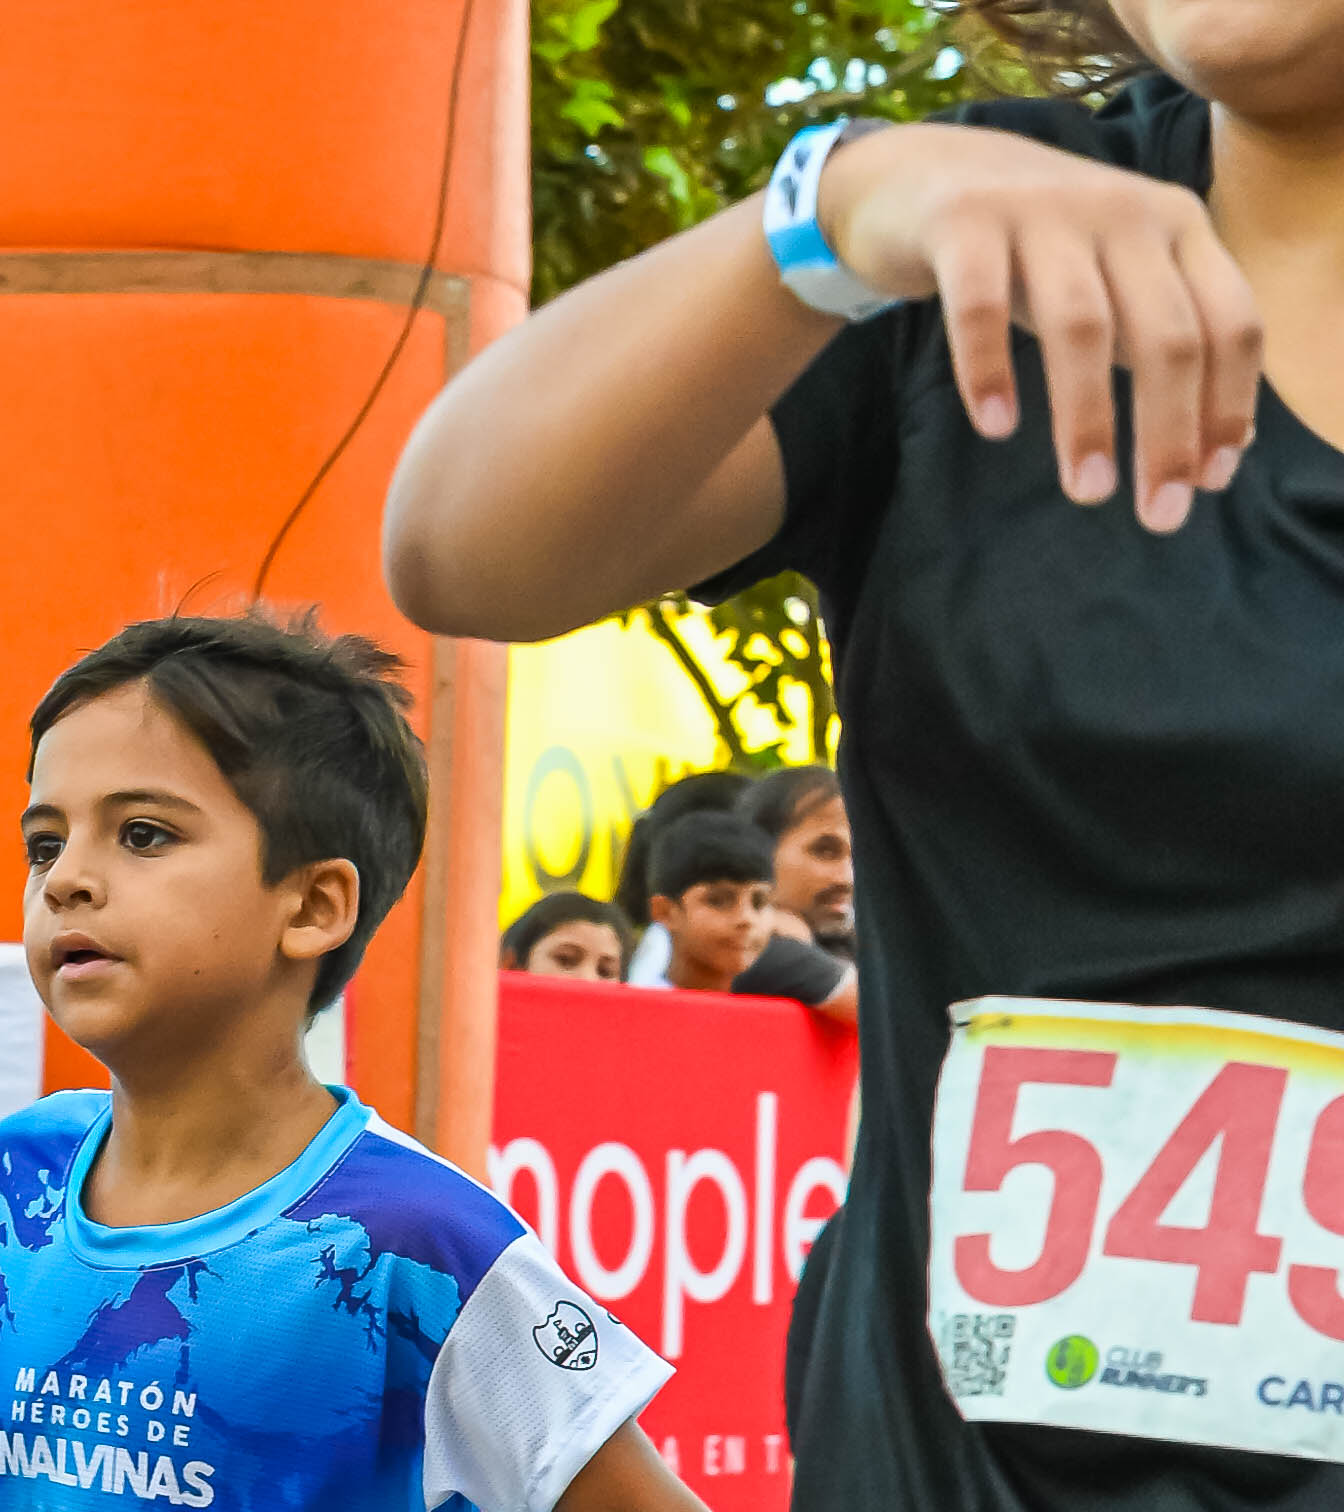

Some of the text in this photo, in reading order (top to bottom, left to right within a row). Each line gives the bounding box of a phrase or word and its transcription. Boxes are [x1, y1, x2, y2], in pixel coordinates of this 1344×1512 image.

[15, 1367, 197, 1418] MARATÓN
[11, 1398, 191, 1447] HÉROES DE
